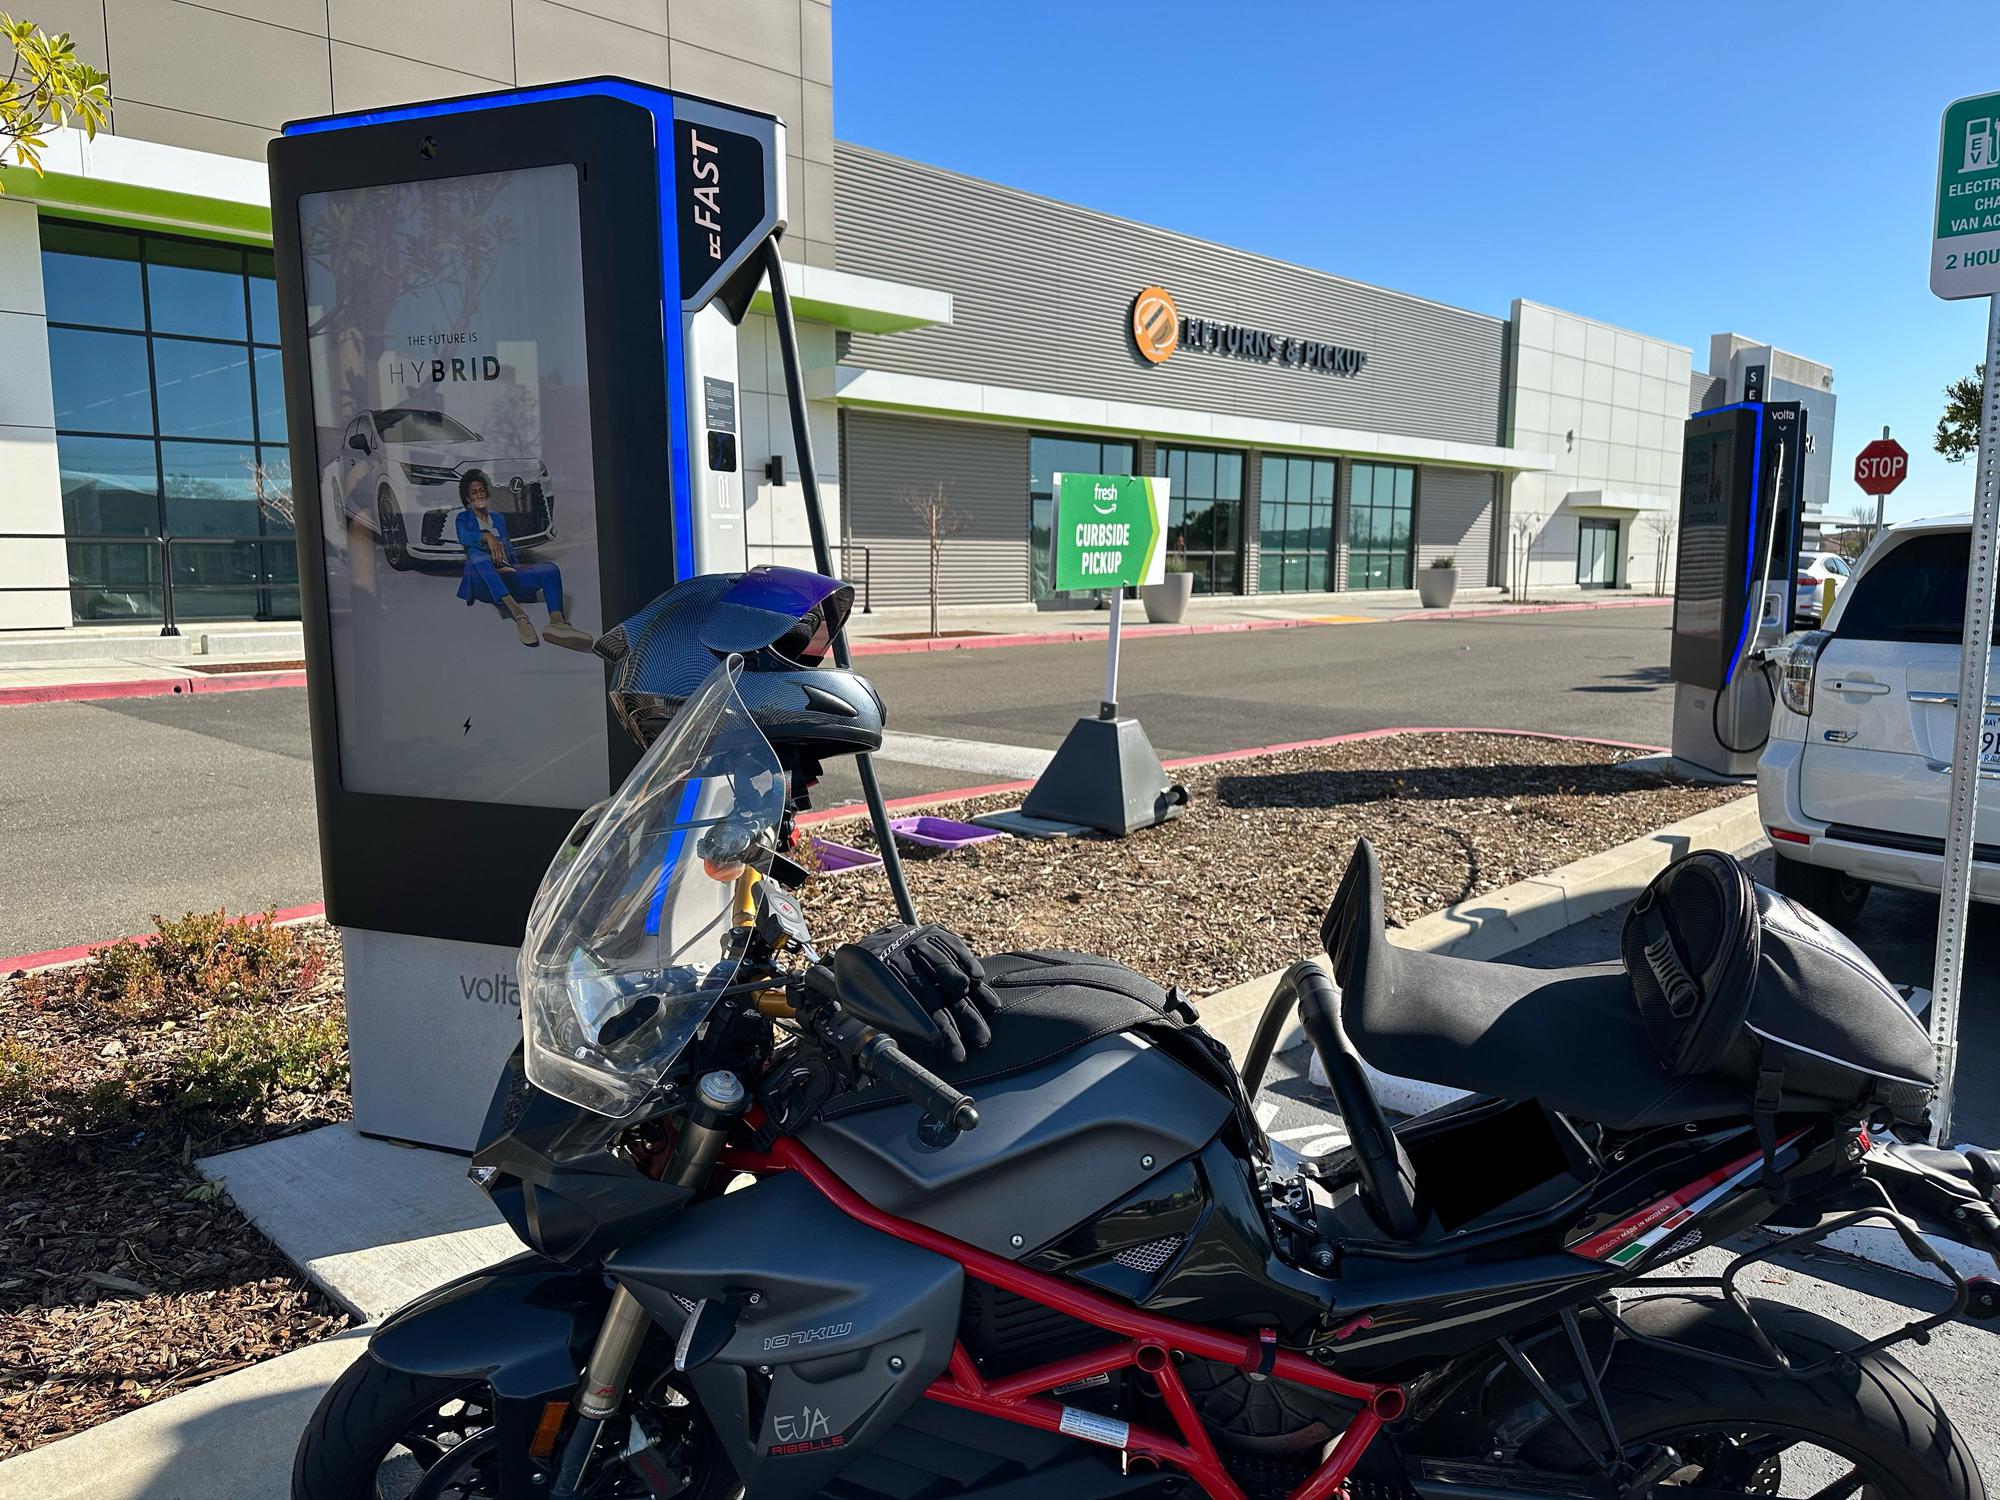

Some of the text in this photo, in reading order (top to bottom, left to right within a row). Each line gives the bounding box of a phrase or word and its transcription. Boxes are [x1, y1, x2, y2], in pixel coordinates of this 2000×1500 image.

[1948, 177, 2000, 197] ELECTR
[1951, 216, 1979, 232] VAN
[1945, 248, 2000, 270] 2 HOU
[408, 331, 478, 346] THE FUTURE IS
[1185, 318, 1368, 375] RETURNS & PICKUP
[389, 355, 501, 384] HYBRID
[1771, 409, 1795, 421] volta
[1858, 456, 1904, 479] STOP
[718, 475, 731, 509] 01
[1094, 482, 1118, 501] fresh
[1075, 523, 1131, 547] CURBSIDE
[1081, 551, 1122, 576] PICKUP
[460, 973, 521, 1006] volta
[1595, 1236, 1621, 1254] PROUDLY
[1620, 1224, 1639, 1238] MADE
[1644, 1204, 1671, 1223] MODENA
[770, 1434, 845, 1457] RIBELLE
